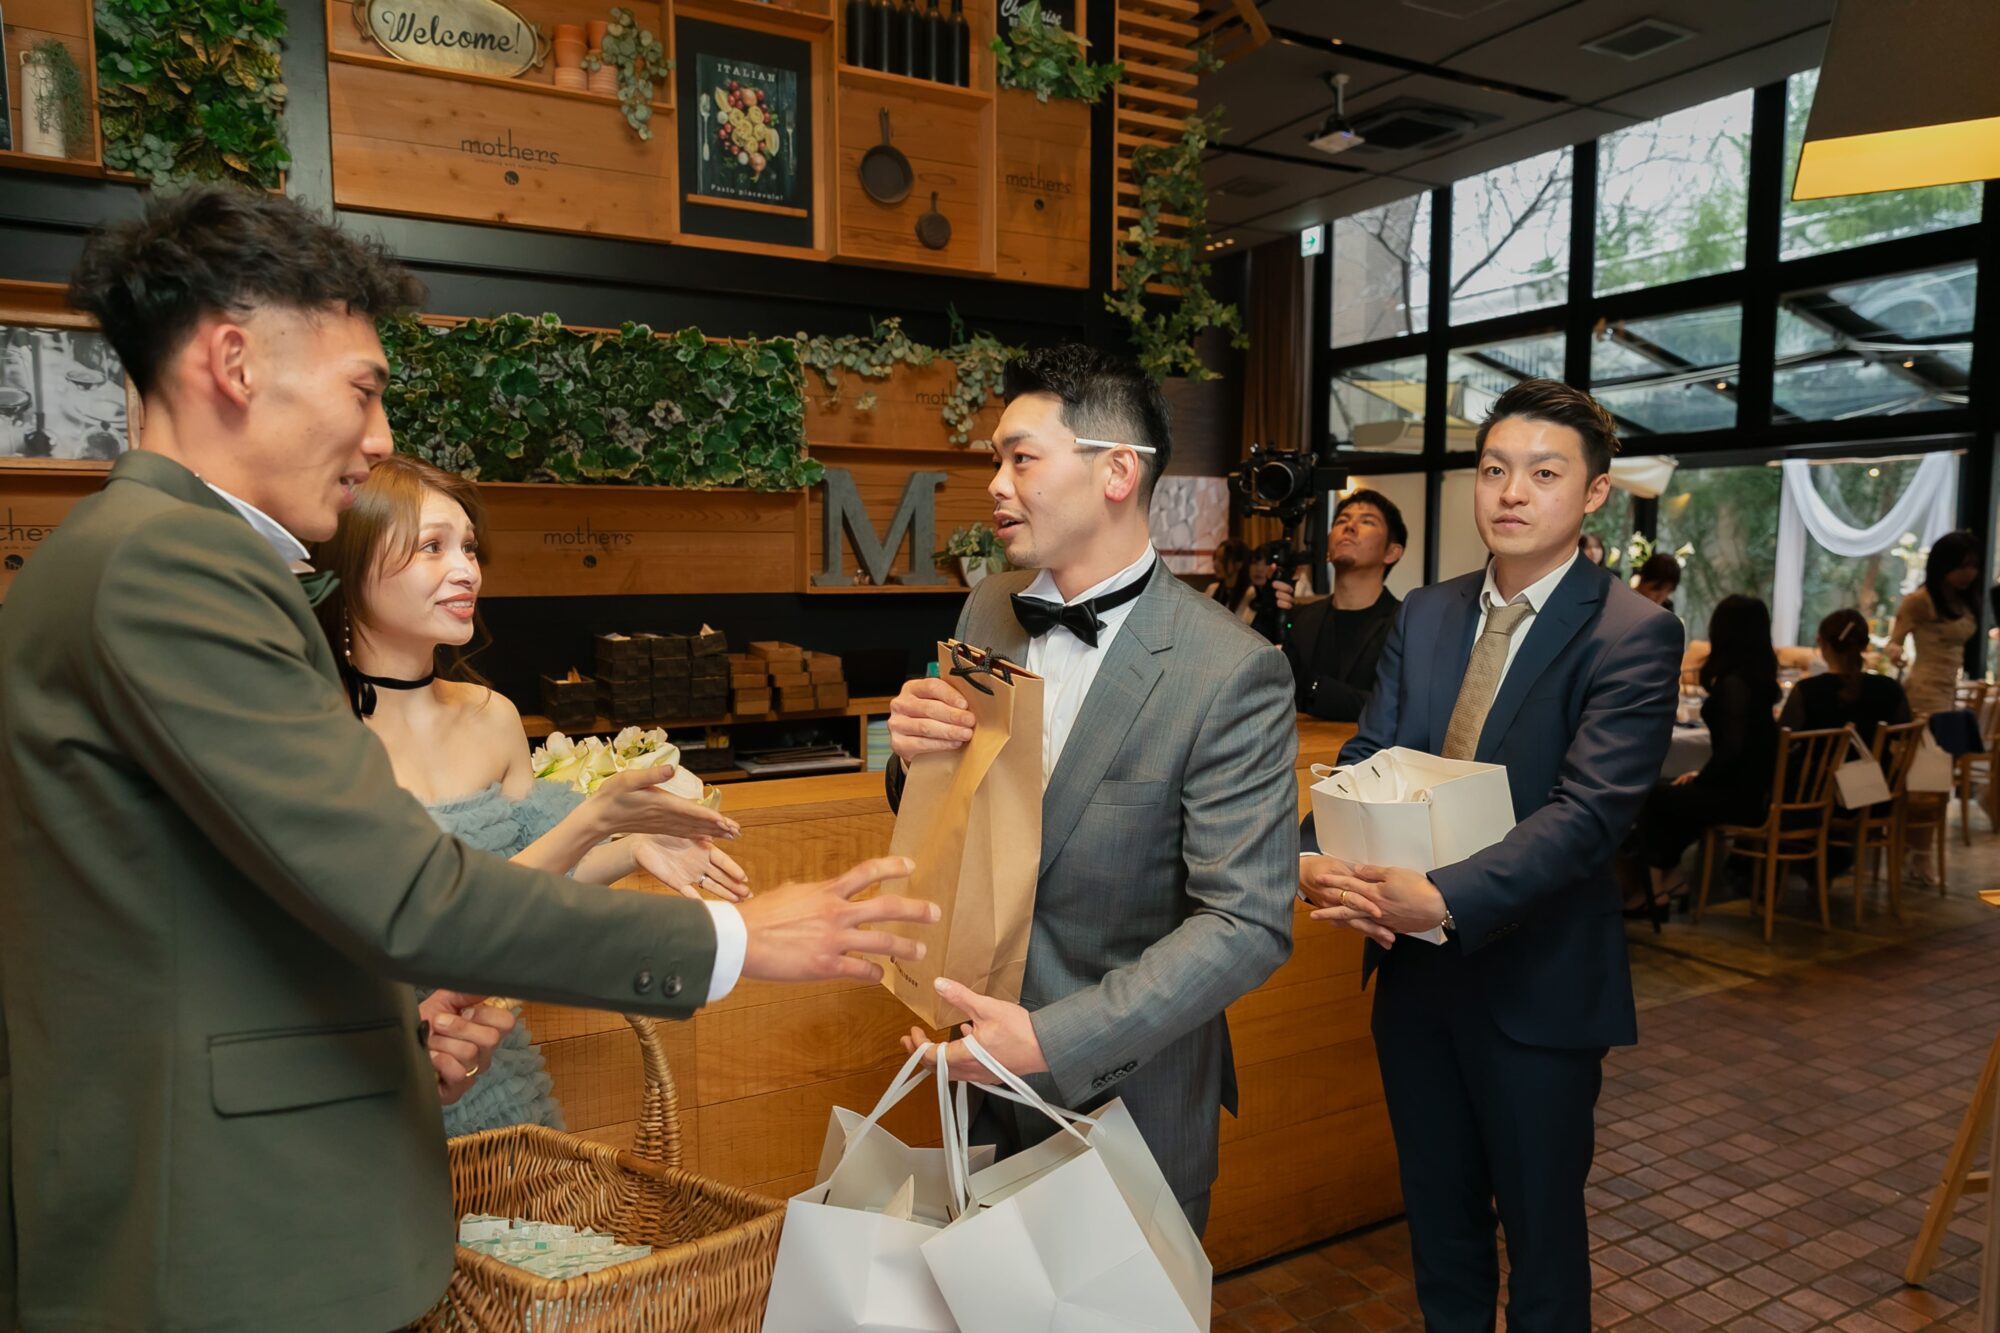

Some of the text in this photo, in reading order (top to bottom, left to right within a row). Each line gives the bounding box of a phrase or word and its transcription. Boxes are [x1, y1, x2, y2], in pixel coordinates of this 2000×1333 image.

[382, 11, 521, 54] Welcome!
[717, 63, 776, 82] ITALIAN
[461, 128, 560, 164] mothers
[1006, 163, 1072, 193] mothers
[543, 516, 635, 545] mothers
[811, 469, 948, 586] M
